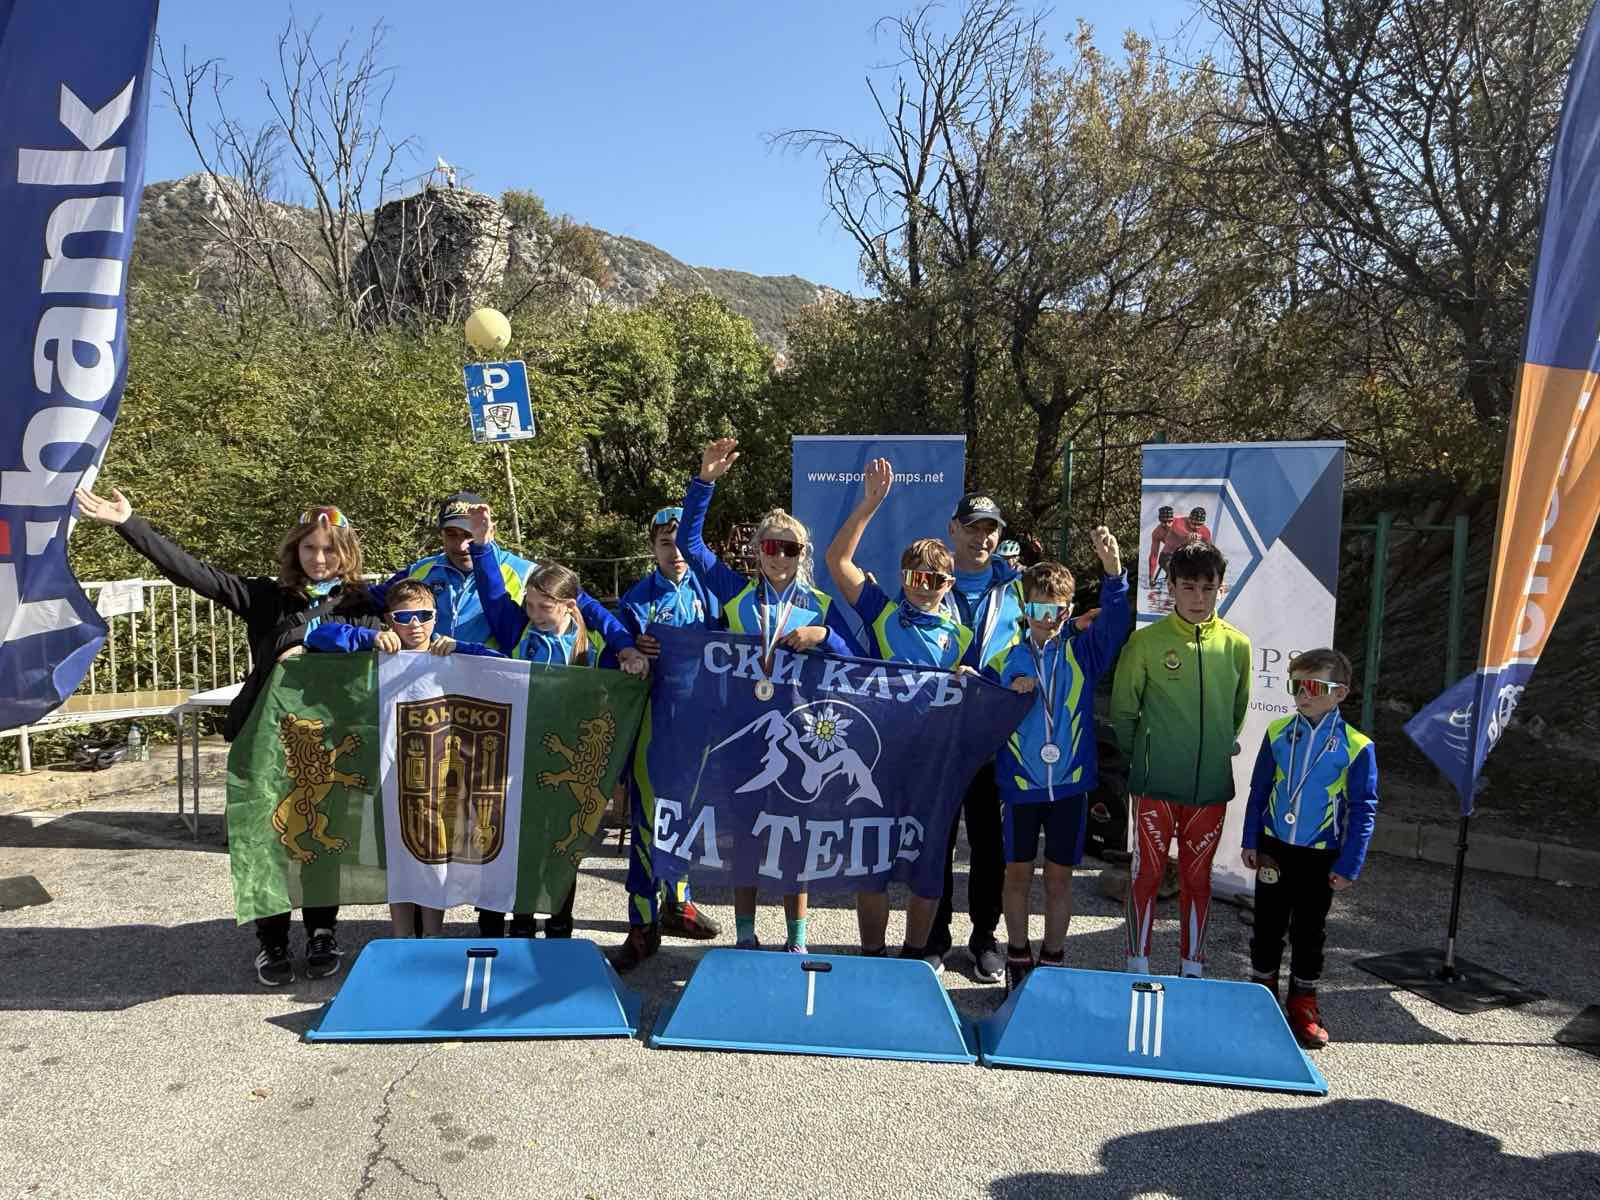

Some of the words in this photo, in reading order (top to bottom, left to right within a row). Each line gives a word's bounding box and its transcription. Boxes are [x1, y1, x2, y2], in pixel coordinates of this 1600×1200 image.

[483, 367, 510, 402] P
[807, 471, 944, 483] www.spormps.net
[704, 641, 809, 687] СКИ
[817, 658, 968, 707] КЛУБ
[408, 705, 500, 728] БАНСКО
[1249, 702, 1289, 714] utions
[654, 797, 724, 868] ЕЛ
[752, 811, 924, 882] ТЕПЕ
